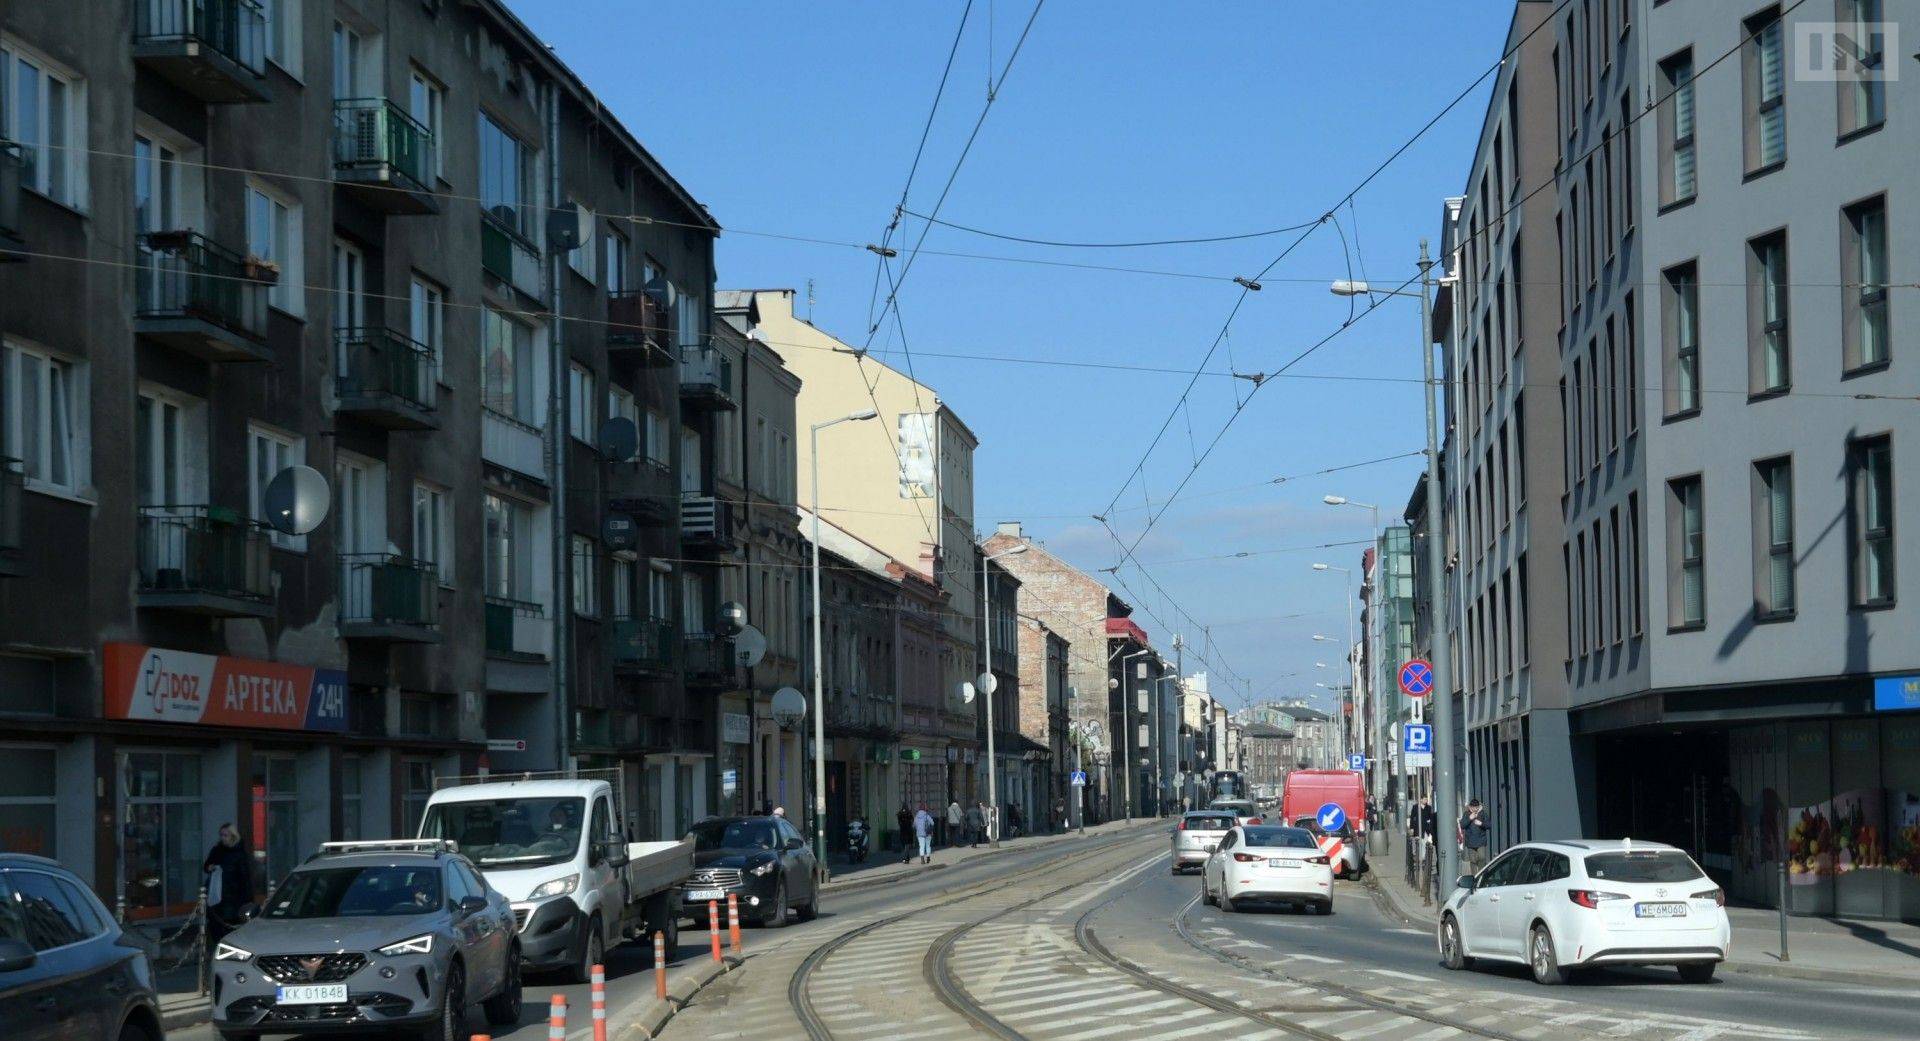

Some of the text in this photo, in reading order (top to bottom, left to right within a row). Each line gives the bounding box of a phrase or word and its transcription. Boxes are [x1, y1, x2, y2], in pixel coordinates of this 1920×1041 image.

[170, 672, 200, 701] DOZ
[224, 672, 344, 718] APTEKA 24H
[1410, 727, 1426, 750] P
[1352, 755, 1362, 769] P
[1641, 904, 1684, 914] WE 6M060
[285, 986, 344, 1000] KK 01848
